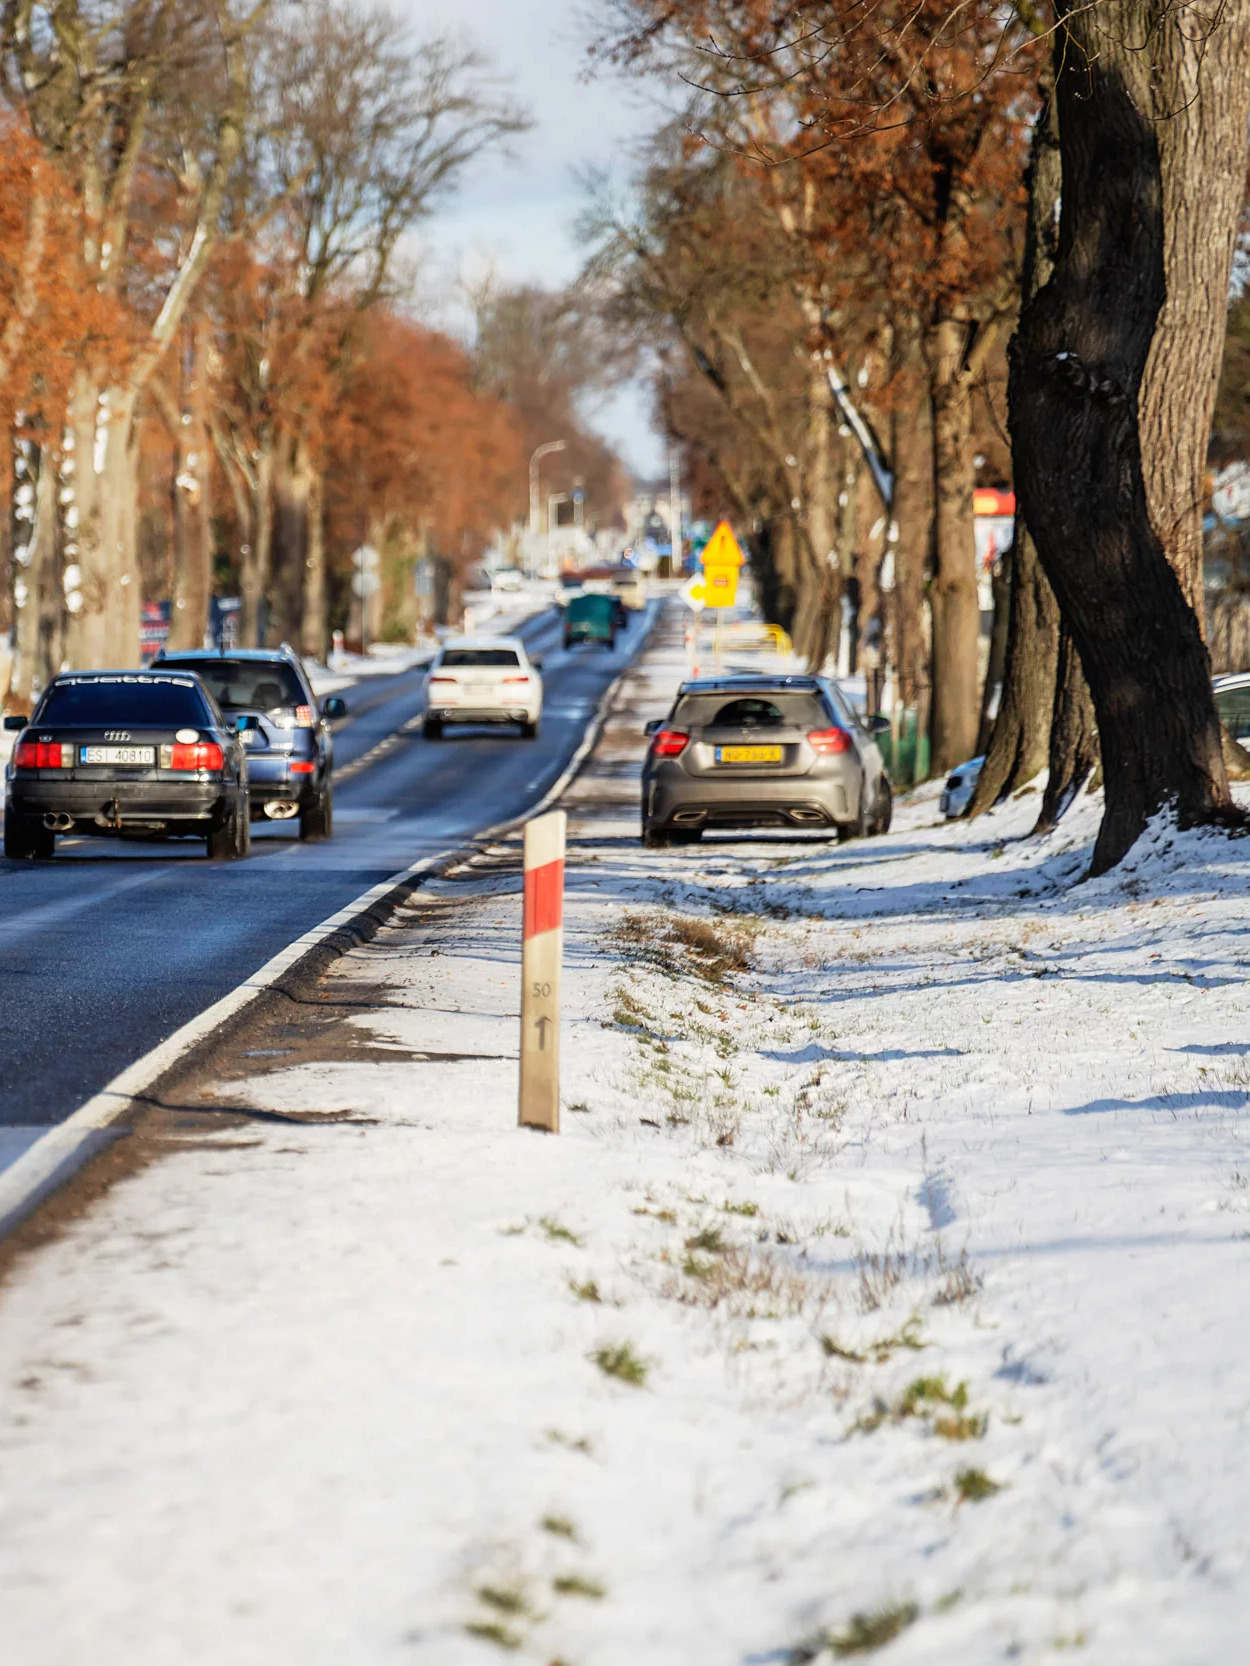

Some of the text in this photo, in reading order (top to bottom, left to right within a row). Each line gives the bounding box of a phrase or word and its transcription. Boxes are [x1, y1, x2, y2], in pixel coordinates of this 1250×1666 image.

[55, 675, 195, 688] quattro
[114, 750, 151, 763] 40810
[532, 982, 552, 998] 50
